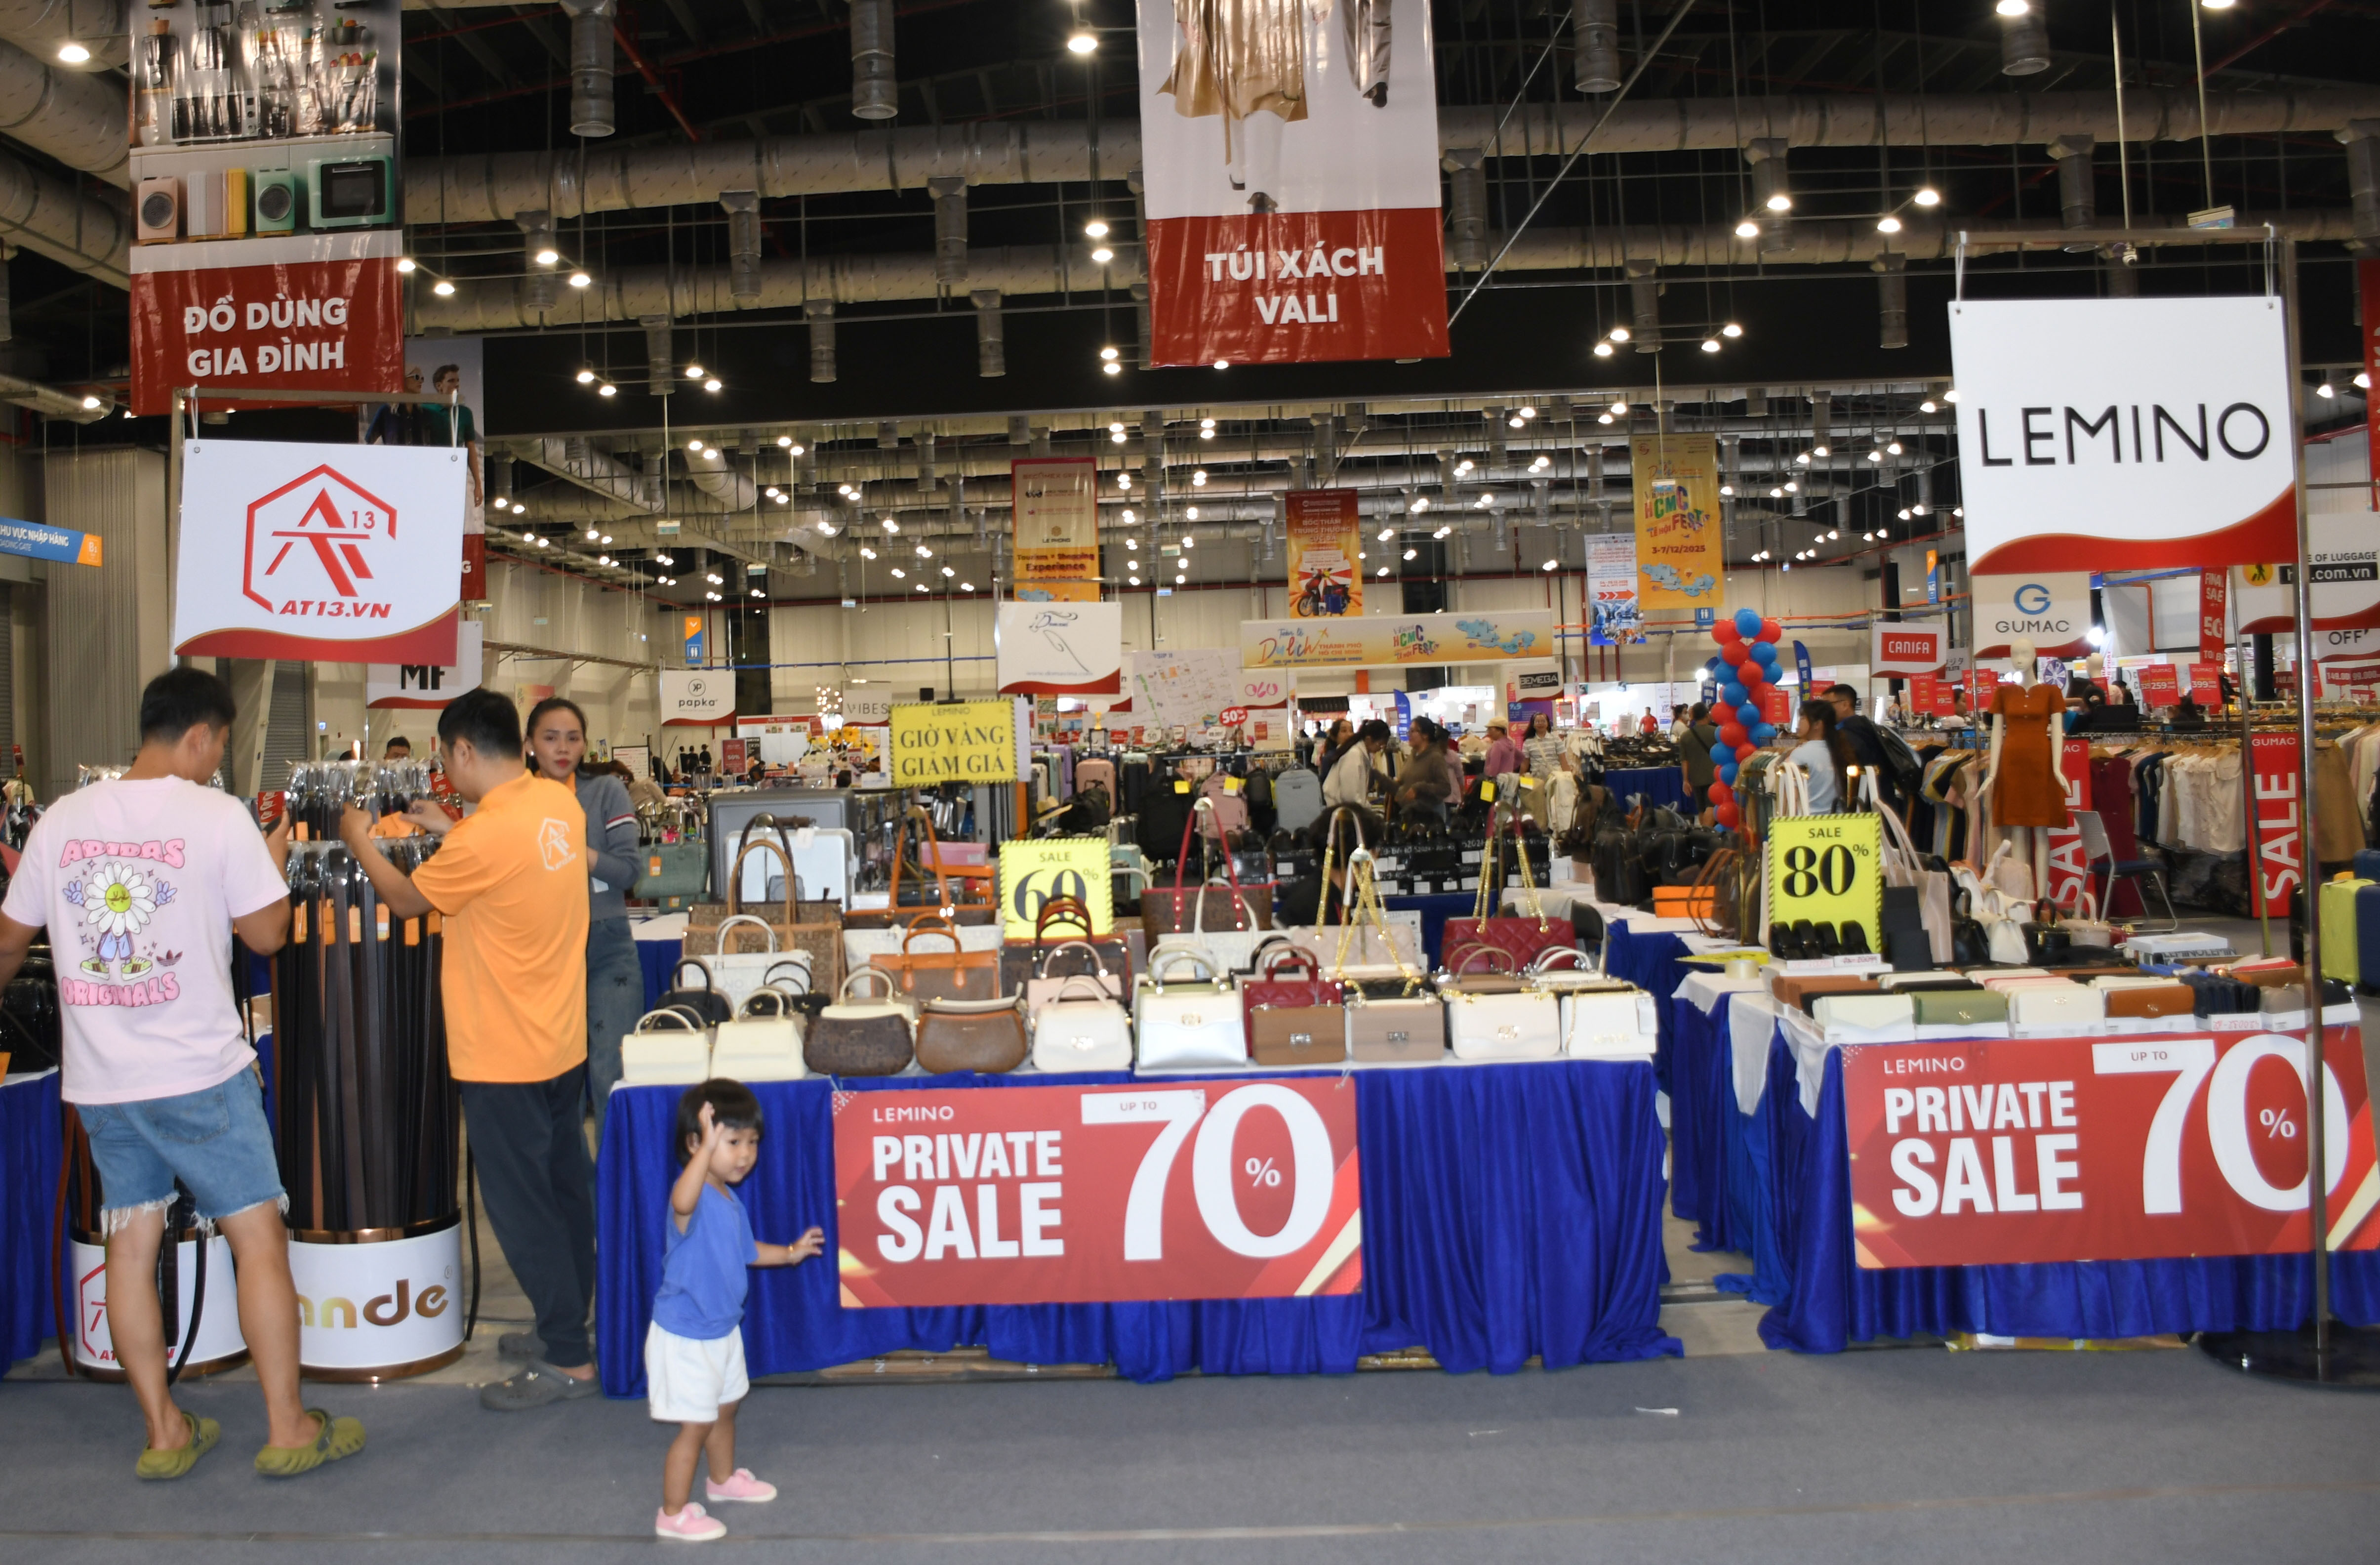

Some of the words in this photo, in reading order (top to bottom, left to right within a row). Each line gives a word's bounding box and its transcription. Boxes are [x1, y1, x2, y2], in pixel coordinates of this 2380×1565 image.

[1206, 244, 1265, 282] TÚI
[1278, 241, 1383, 279] XÁCH
[185, 295, 236, 334] ĐỒ
[246, 293, 348, 331] DÙNG
[1255, 294, 1338, 325] VALI
[188, 348, 248, 377] GIA
[257, 341, 344, 373] ĐÌNH
[1978, 402, 2270, 467] LEMINO
[1645, 486, 1689, 519] HCMC
[0, 524, 11, 536] HU
[1652, 545, 1705, 554] 3-7/12/2025
[2315, 553, 2327, 562] OF
[2331, 551, 2377, 561] LUGGAGE
[1026, 563, 1086, 572] Experience
[279, 600, 393, 619] AT13.VN
[1393, 625, 1423, 647] HCMC
[1995, 620, 2069, 633] GUMAC
[1889, 641, 1930, 654] CANIFA
[679, 698, 715, 708] papka
[932, 707, 970, 716] LEMINO
[901, 723, 939, 748] GIỜ
[946, 722, 1004, 746] VÀNG
[2252, 737, 2296, 747] GUMAC
[902, 750, 959, 777] GIẢM
[967, 747, 1005, 774] GIÁ
[1808, 827, 1841, 839] SALE
[2254, 772, 2301, 899] SALE
[59, 838, 185, 869] ADIDAS
[1040, 851, 1071, 863] SALE
[62, 971, 180, 1007] ORIGINALS
[1884, 1057, 1965, 1074] LEMINO
[2131, 1051, 2148, 1062] UP
[2152, 1050, 2168, 1061] TO
[873, 1105, 955, 1123] LEMINO
[1120, 1101, 1137, 1112] UP
[1141, 1100, 1158, 1111] TO
[1884, 1080, 2077, 1134] PRIVATE
[873, 1130, 1062, 1182] PRIVATE
[1890, 1133, 2083, 1217] SALE
[876, 1181, 1065, 1263] SALE
